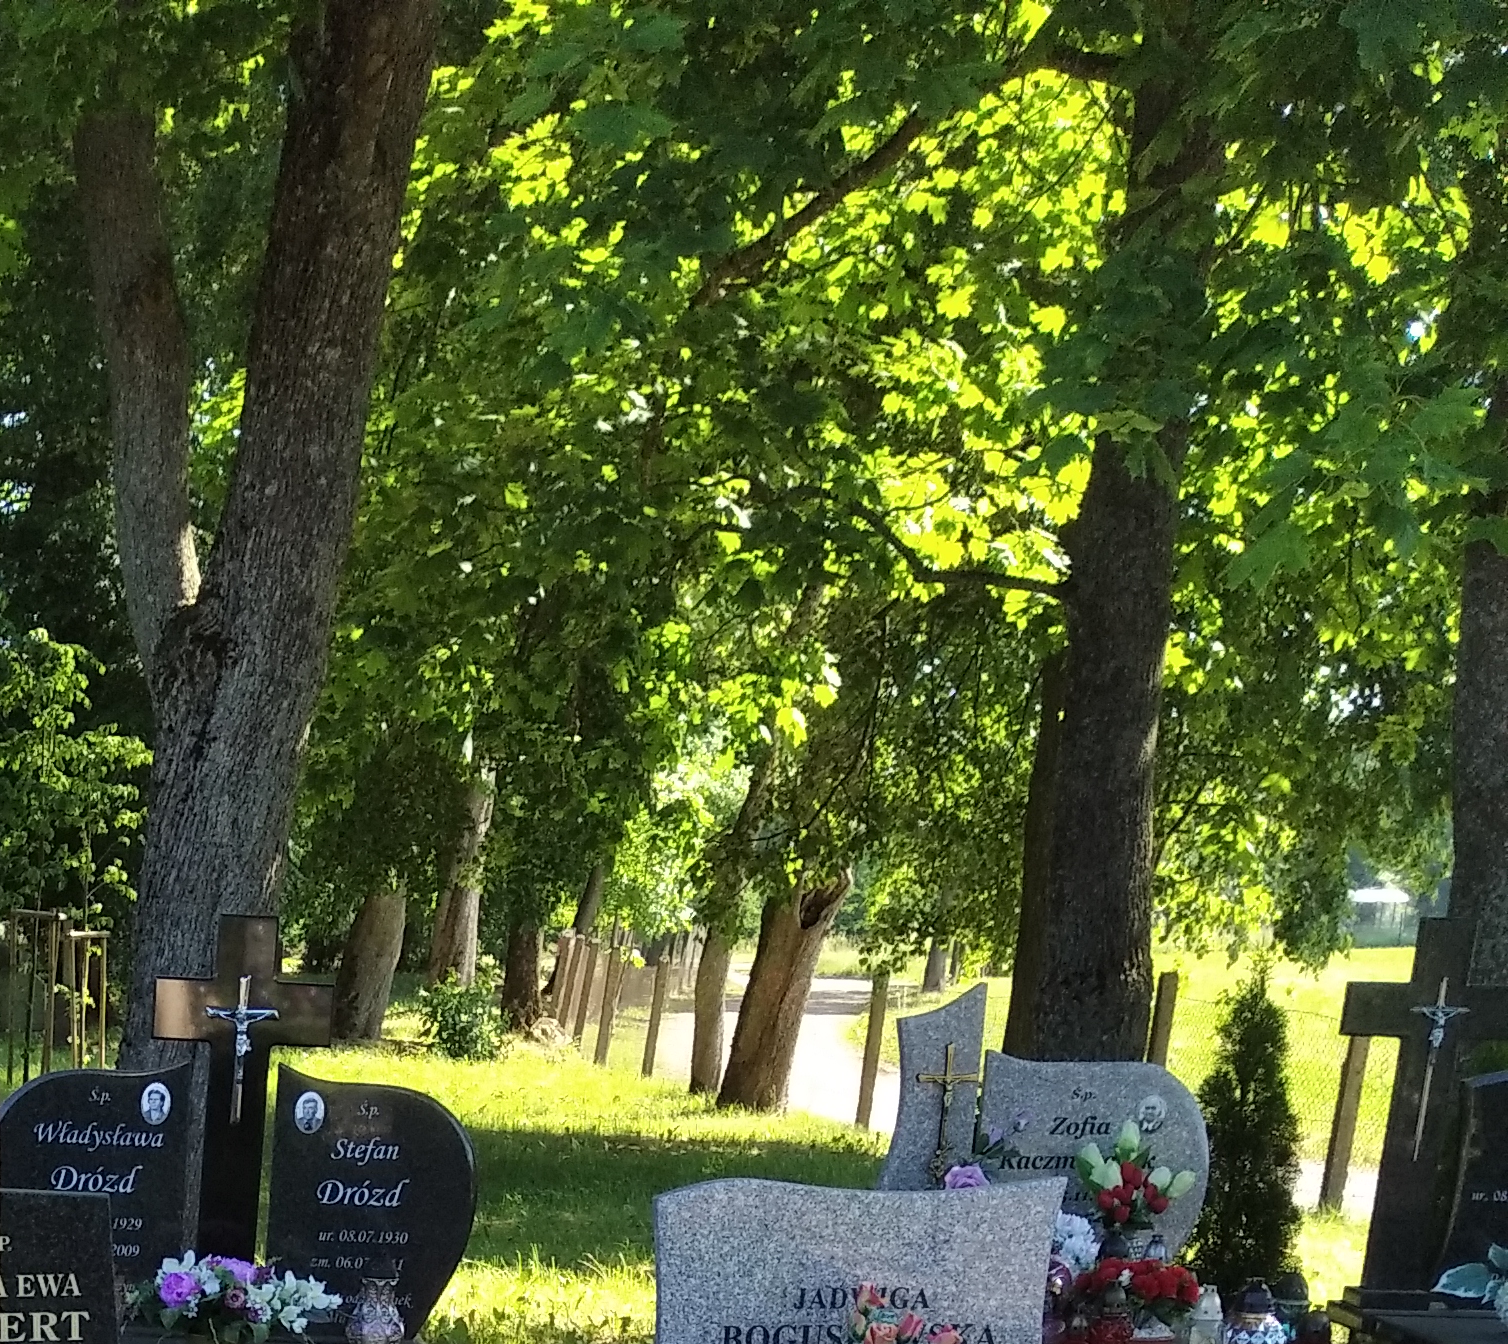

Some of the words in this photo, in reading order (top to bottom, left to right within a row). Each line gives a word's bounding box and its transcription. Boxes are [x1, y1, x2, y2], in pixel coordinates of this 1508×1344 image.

[88, 1085, 112, 1105] Ś.p.
[357, 1100, 381, 1119] Ś.p.
[33, 1120, 165, 1152] Władysława
[1048, 1116, 1112, 1139] Zofia
[330, 1136, 400, 1166] Stefan
[50, 1165, 144, 1194] Drózd
[316, 1178, 410, 1207] Drózd
[318, 1231, 335, 1242] ur.
[338, 1229, 409, 1244] 08.07.1930
[310, 1256, 332, 1269] zm.
[15, 1272, 83, 1298] EWA
